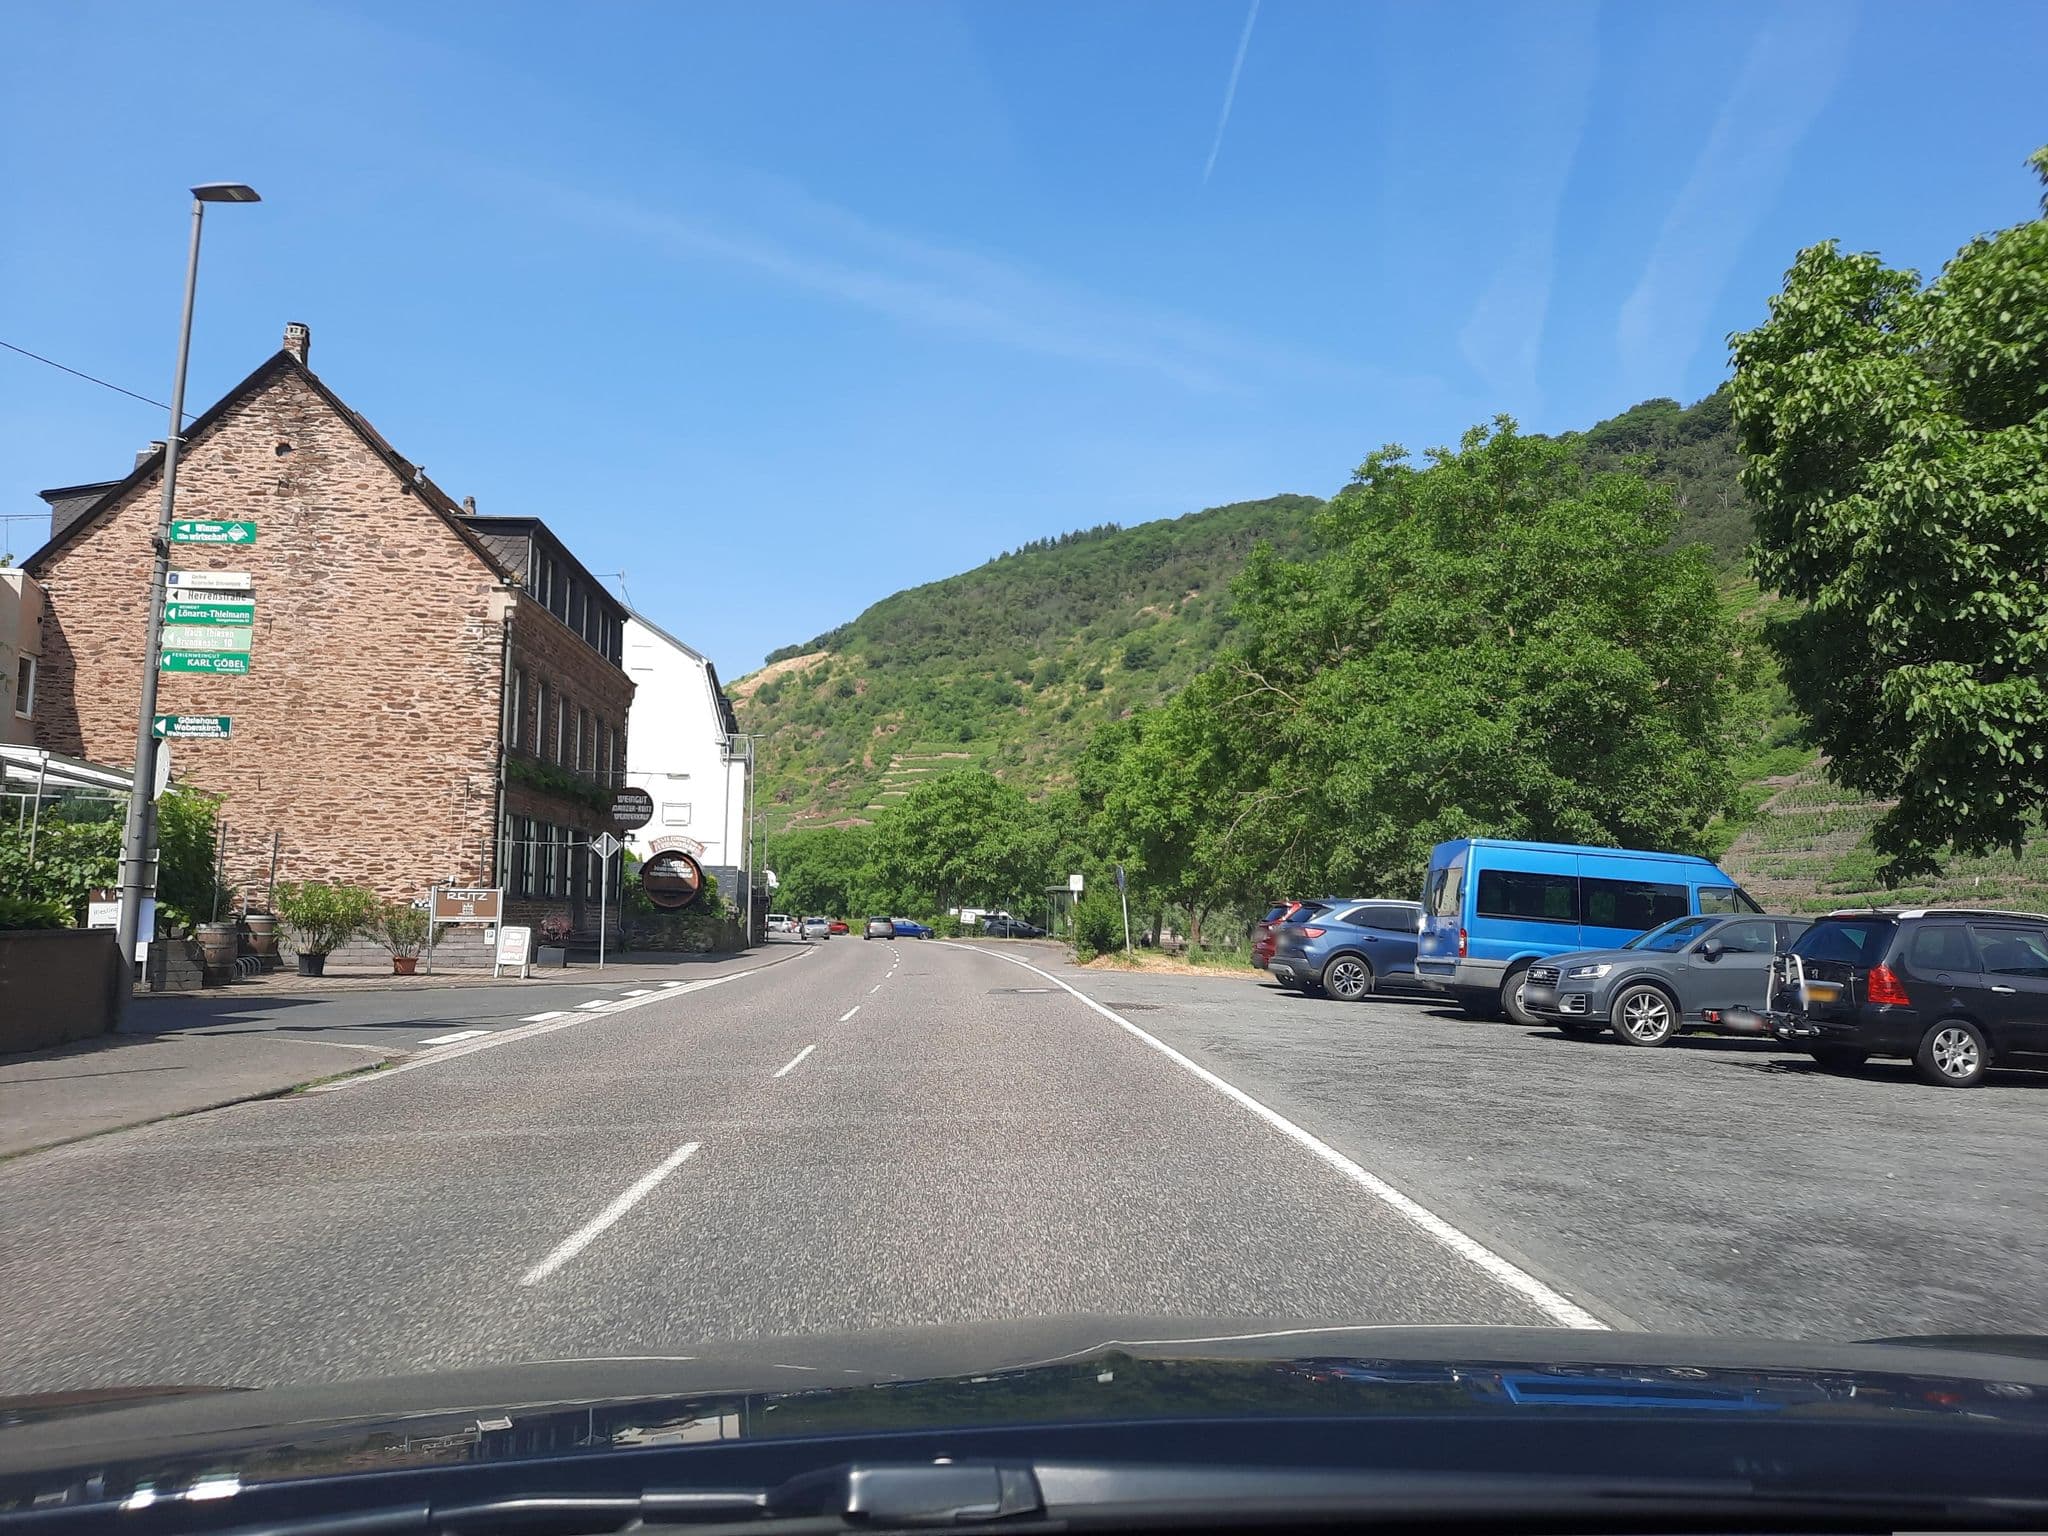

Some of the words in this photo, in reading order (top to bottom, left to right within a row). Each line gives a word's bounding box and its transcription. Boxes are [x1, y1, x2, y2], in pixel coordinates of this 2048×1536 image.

[188, 591, 246, 601] Herrenstraße
[178, 610, 250, 619] Lönartz-Thielmann
[224, 639, 233, 648] 10
[187, 659, 212, 667] KARL
[213, 659, 245, 668] GÖBEL
[178, 716, 219, 724] Gästehaus
[617, 794, 648, 804] WEINGUT
[447, 892, 488, 902] REITZ
